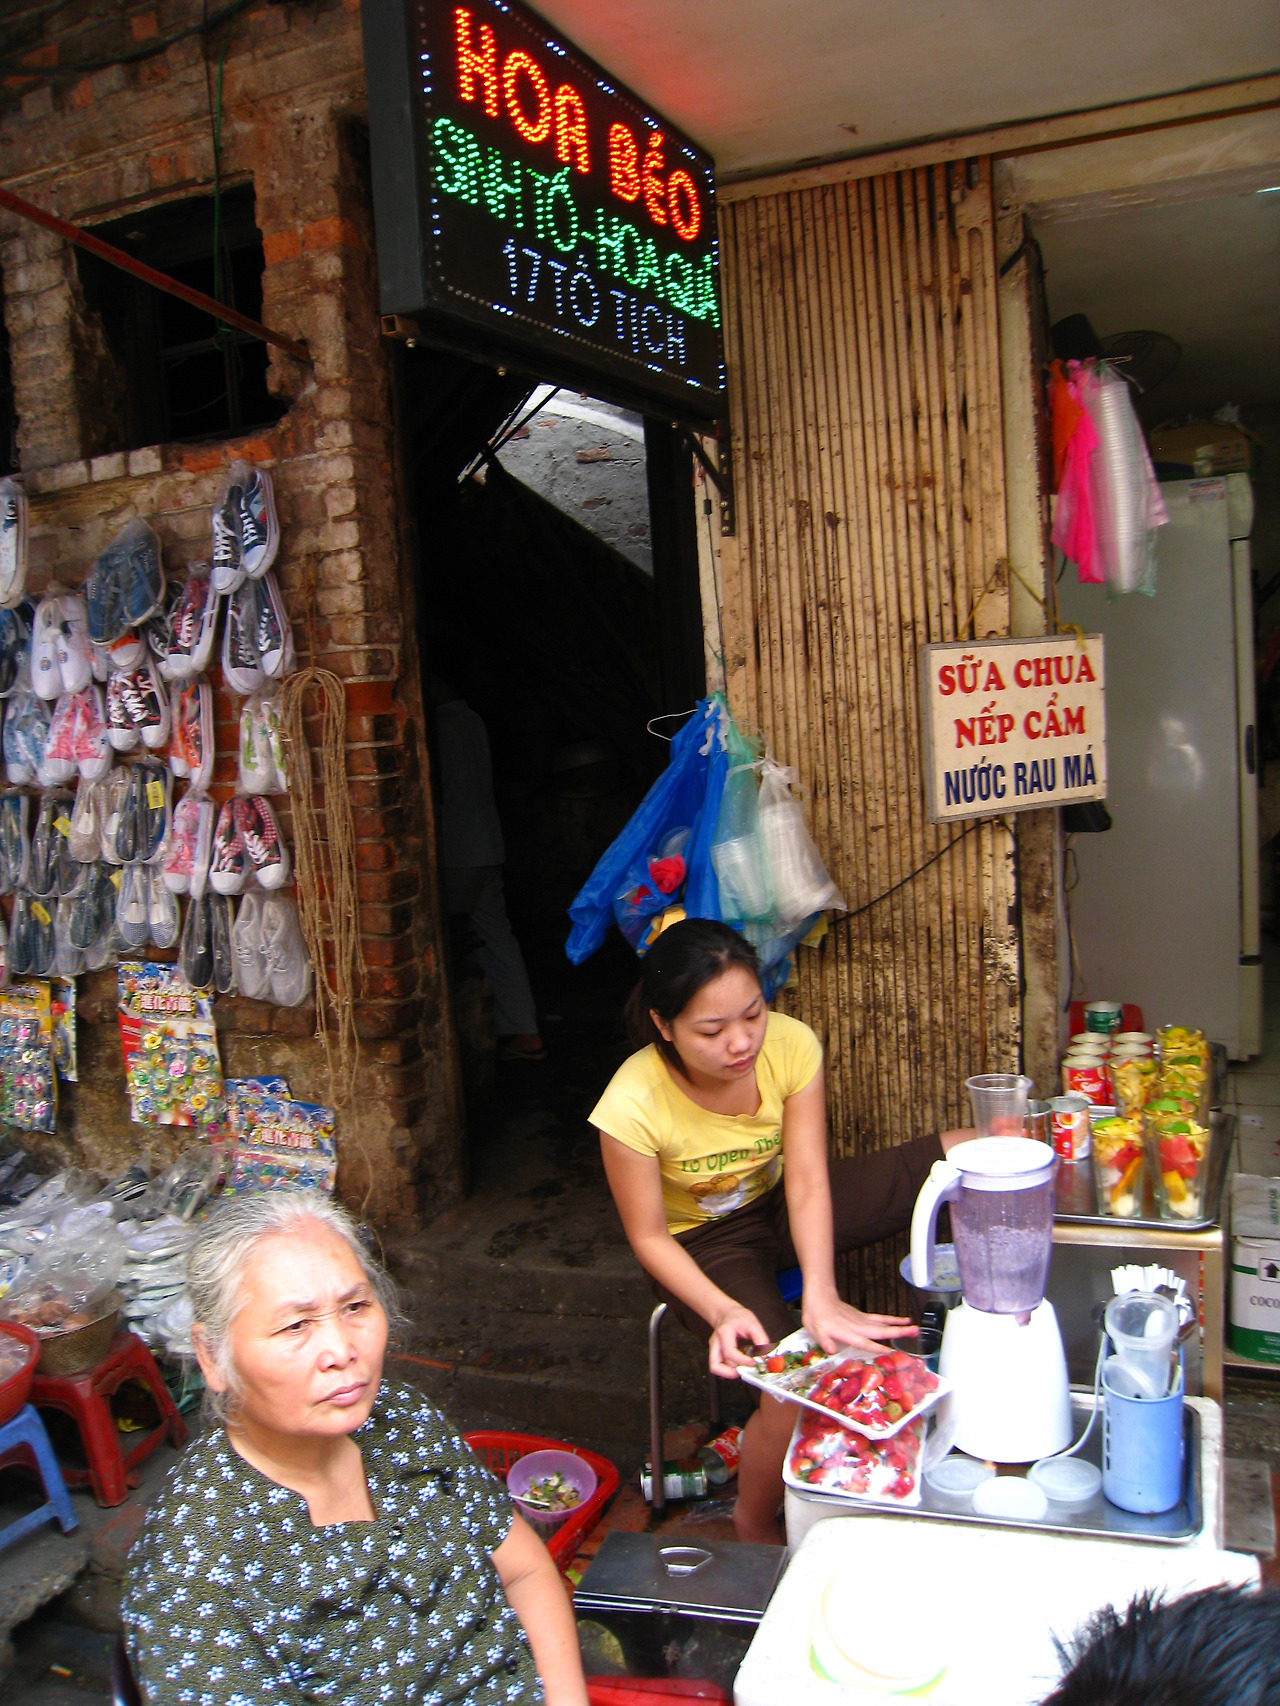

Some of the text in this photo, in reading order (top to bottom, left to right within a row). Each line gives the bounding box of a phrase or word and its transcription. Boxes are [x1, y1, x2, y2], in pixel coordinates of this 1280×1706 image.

[454, 8, 592, 175] HOA
[502, 237, 542, 302] 17
[938, 654, 1097, 696] SỮA CHUA
[954, 691, 1086, 749] NẾP CẨM
[944, 744, 1097, 806] NƯỚC RAU MÁ
[706, 1149, 749, 1171] Open
